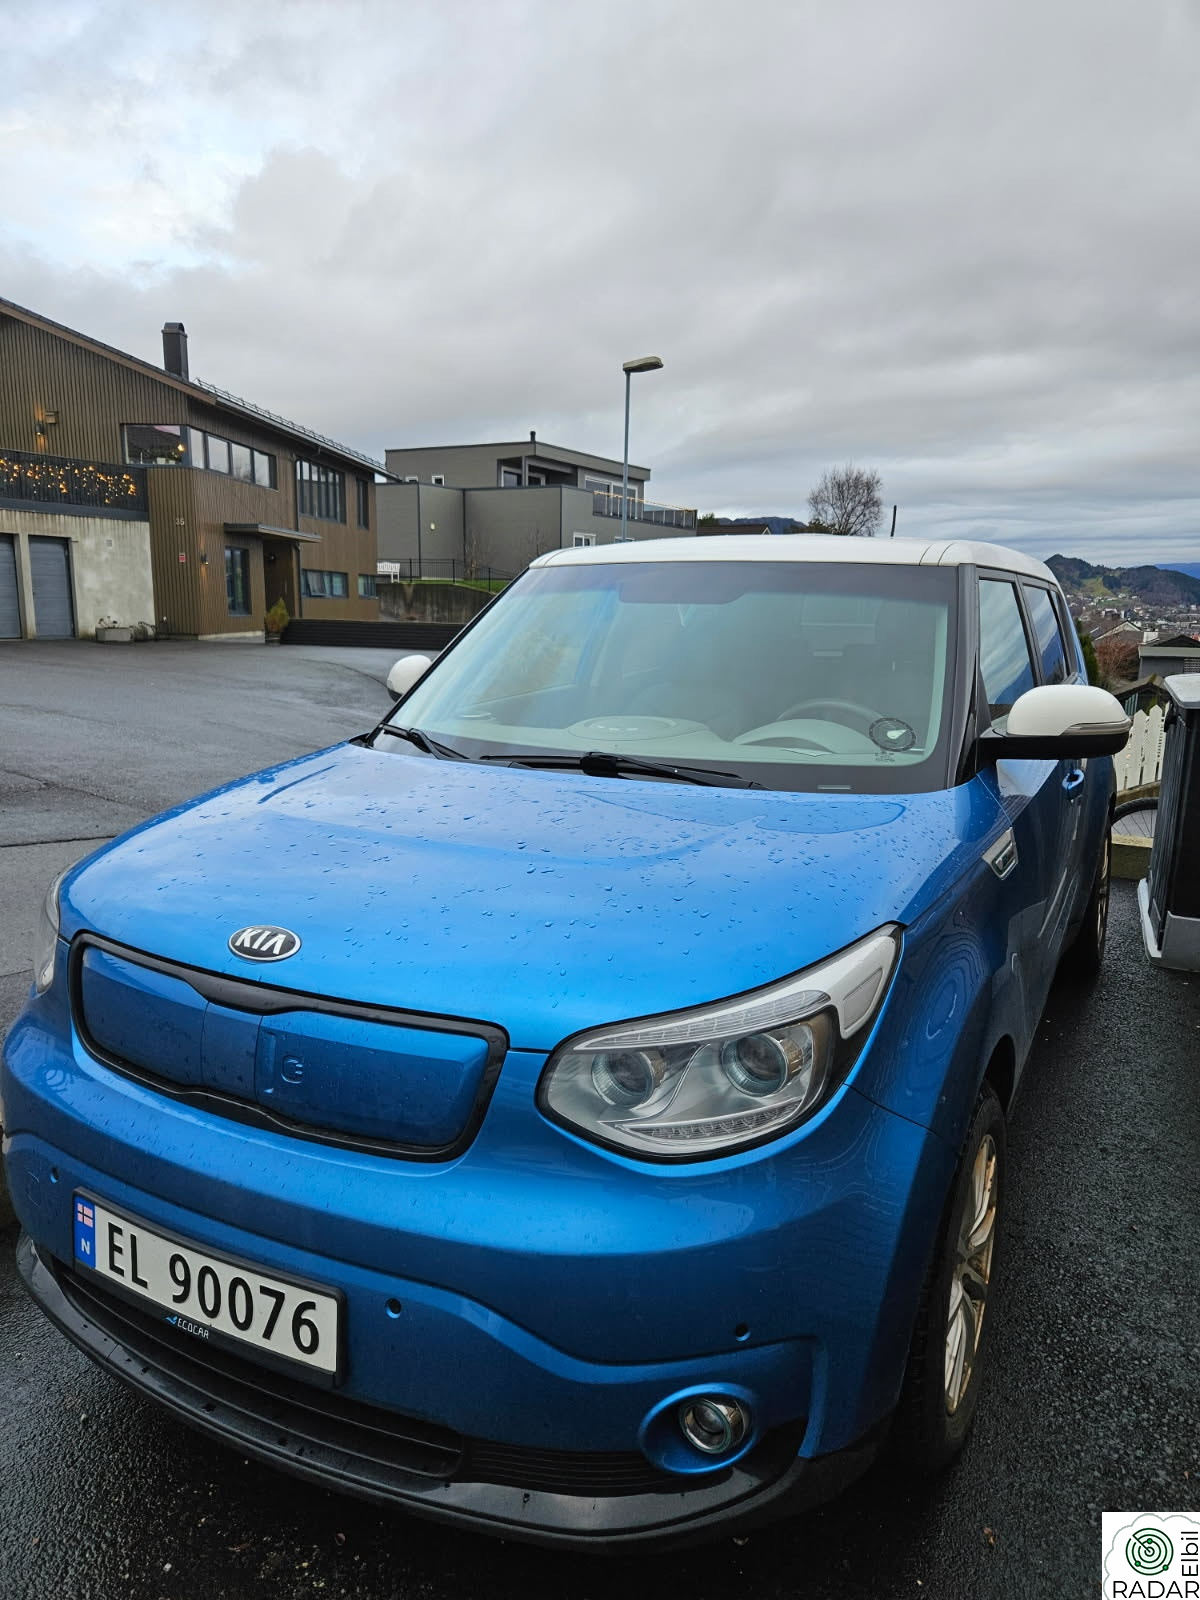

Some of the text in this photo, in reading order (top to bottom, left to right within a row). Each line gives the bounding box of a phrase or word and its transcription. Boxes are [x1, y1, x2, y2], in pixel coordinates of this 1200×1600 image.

[234, 928, 287, 955] KIA
[81, 1237, 90, 1254] N
[107, 1221, 320, 1355] EL 90076
[177, 1318, 209, 1340] ECOCAR
